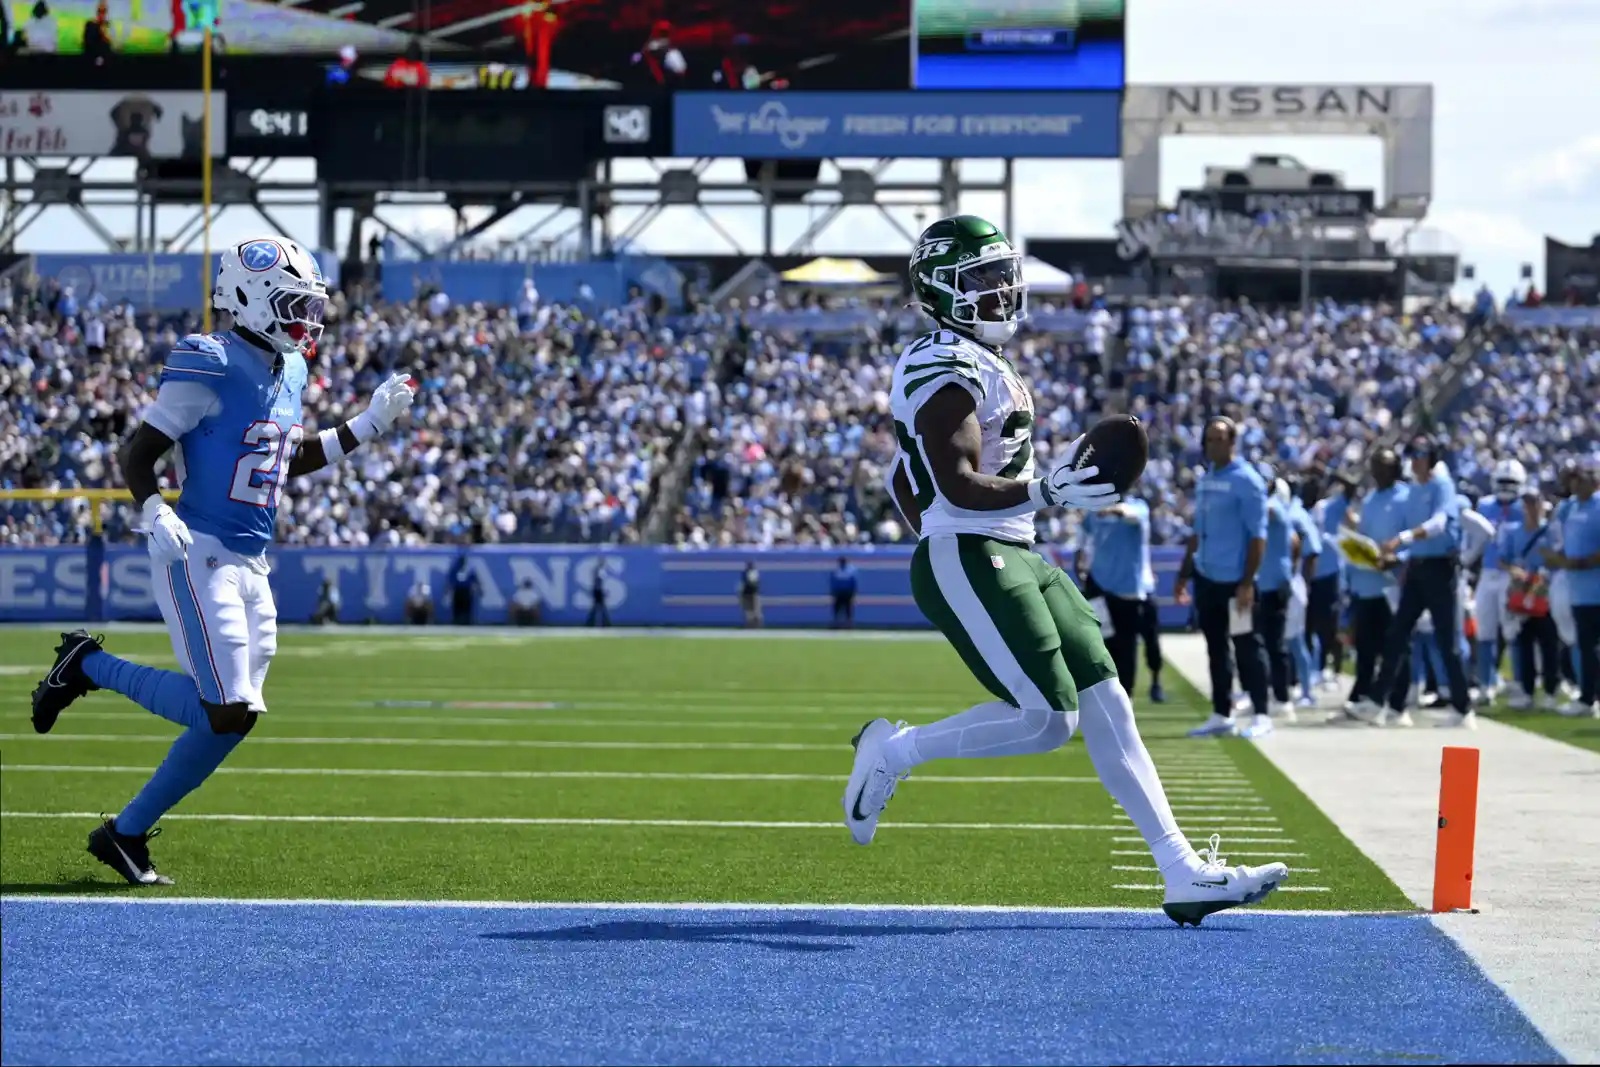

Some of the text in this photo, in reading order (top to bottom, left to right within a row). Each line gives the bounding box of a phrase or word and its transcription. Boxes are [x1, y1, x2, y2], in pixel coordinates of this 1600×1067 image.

[1166, 86, 1391, 114] NISSAN
[250, 108, 308, 135] 9:41
[913, 114, 955, 135] FOR
